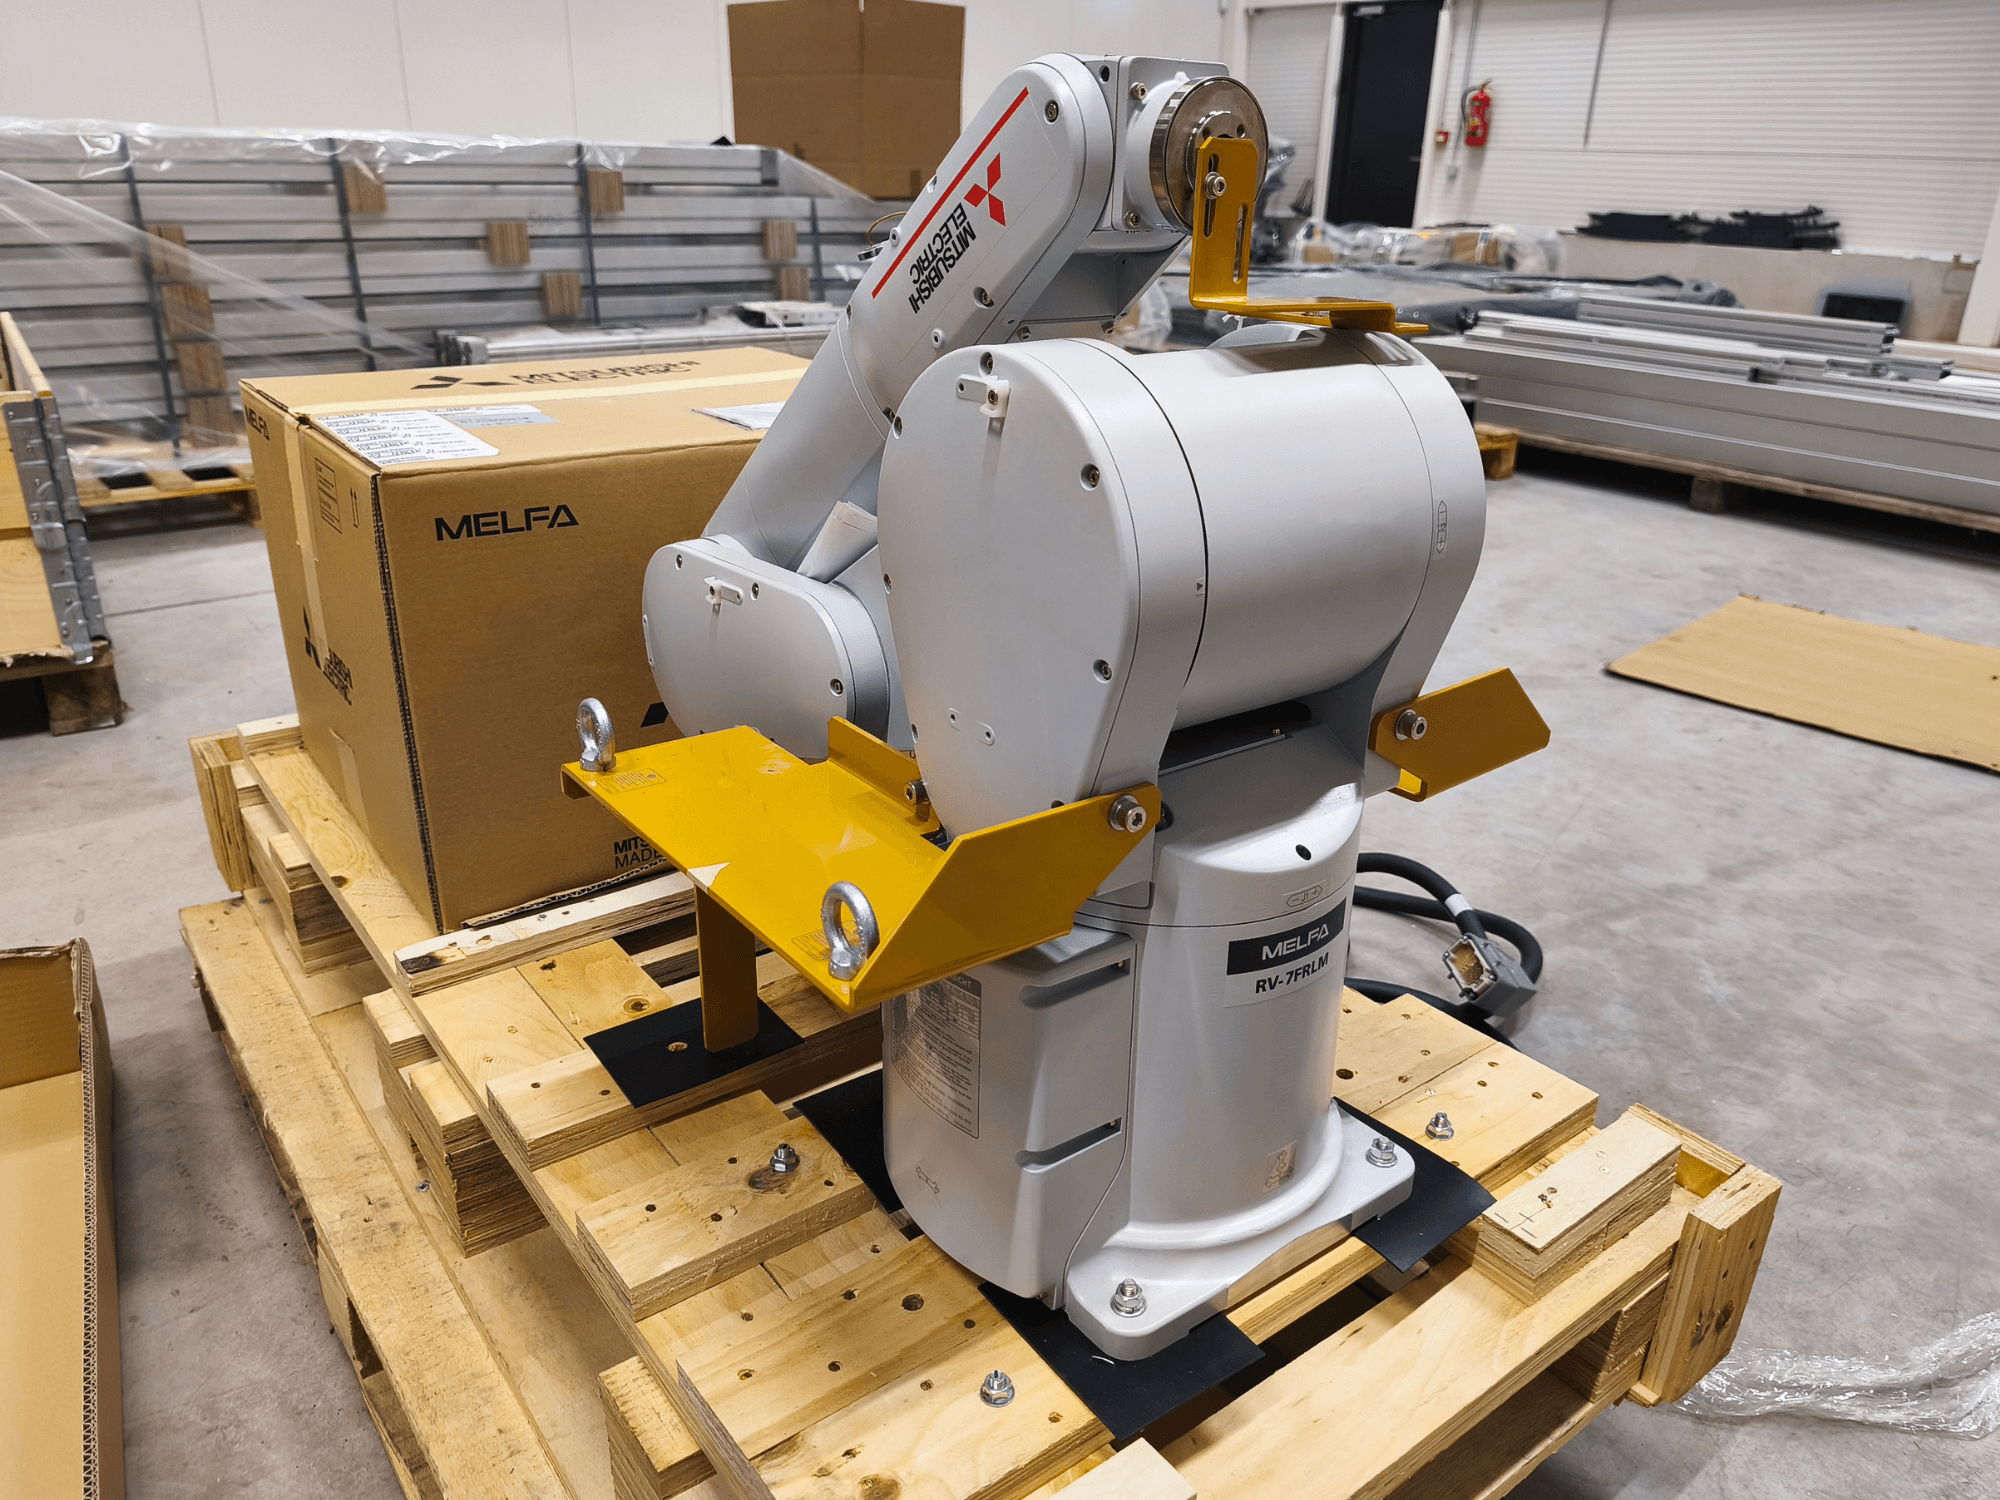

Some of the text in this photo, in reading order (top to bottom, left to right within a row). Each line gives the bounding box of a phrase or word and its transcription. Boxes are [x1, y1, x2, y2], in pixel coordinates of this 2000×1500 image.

[909, 202, 968, 285] ELECTRIC
[908, 221, 977, 314] MITSUBISHI
[244, 404, 270, 441] MELFA
[434, 504, 580, 542] MELFA
[1261, 923, 1330, 961] MELFA
[1254, 951, 1330, 994] RV-7FRLM
